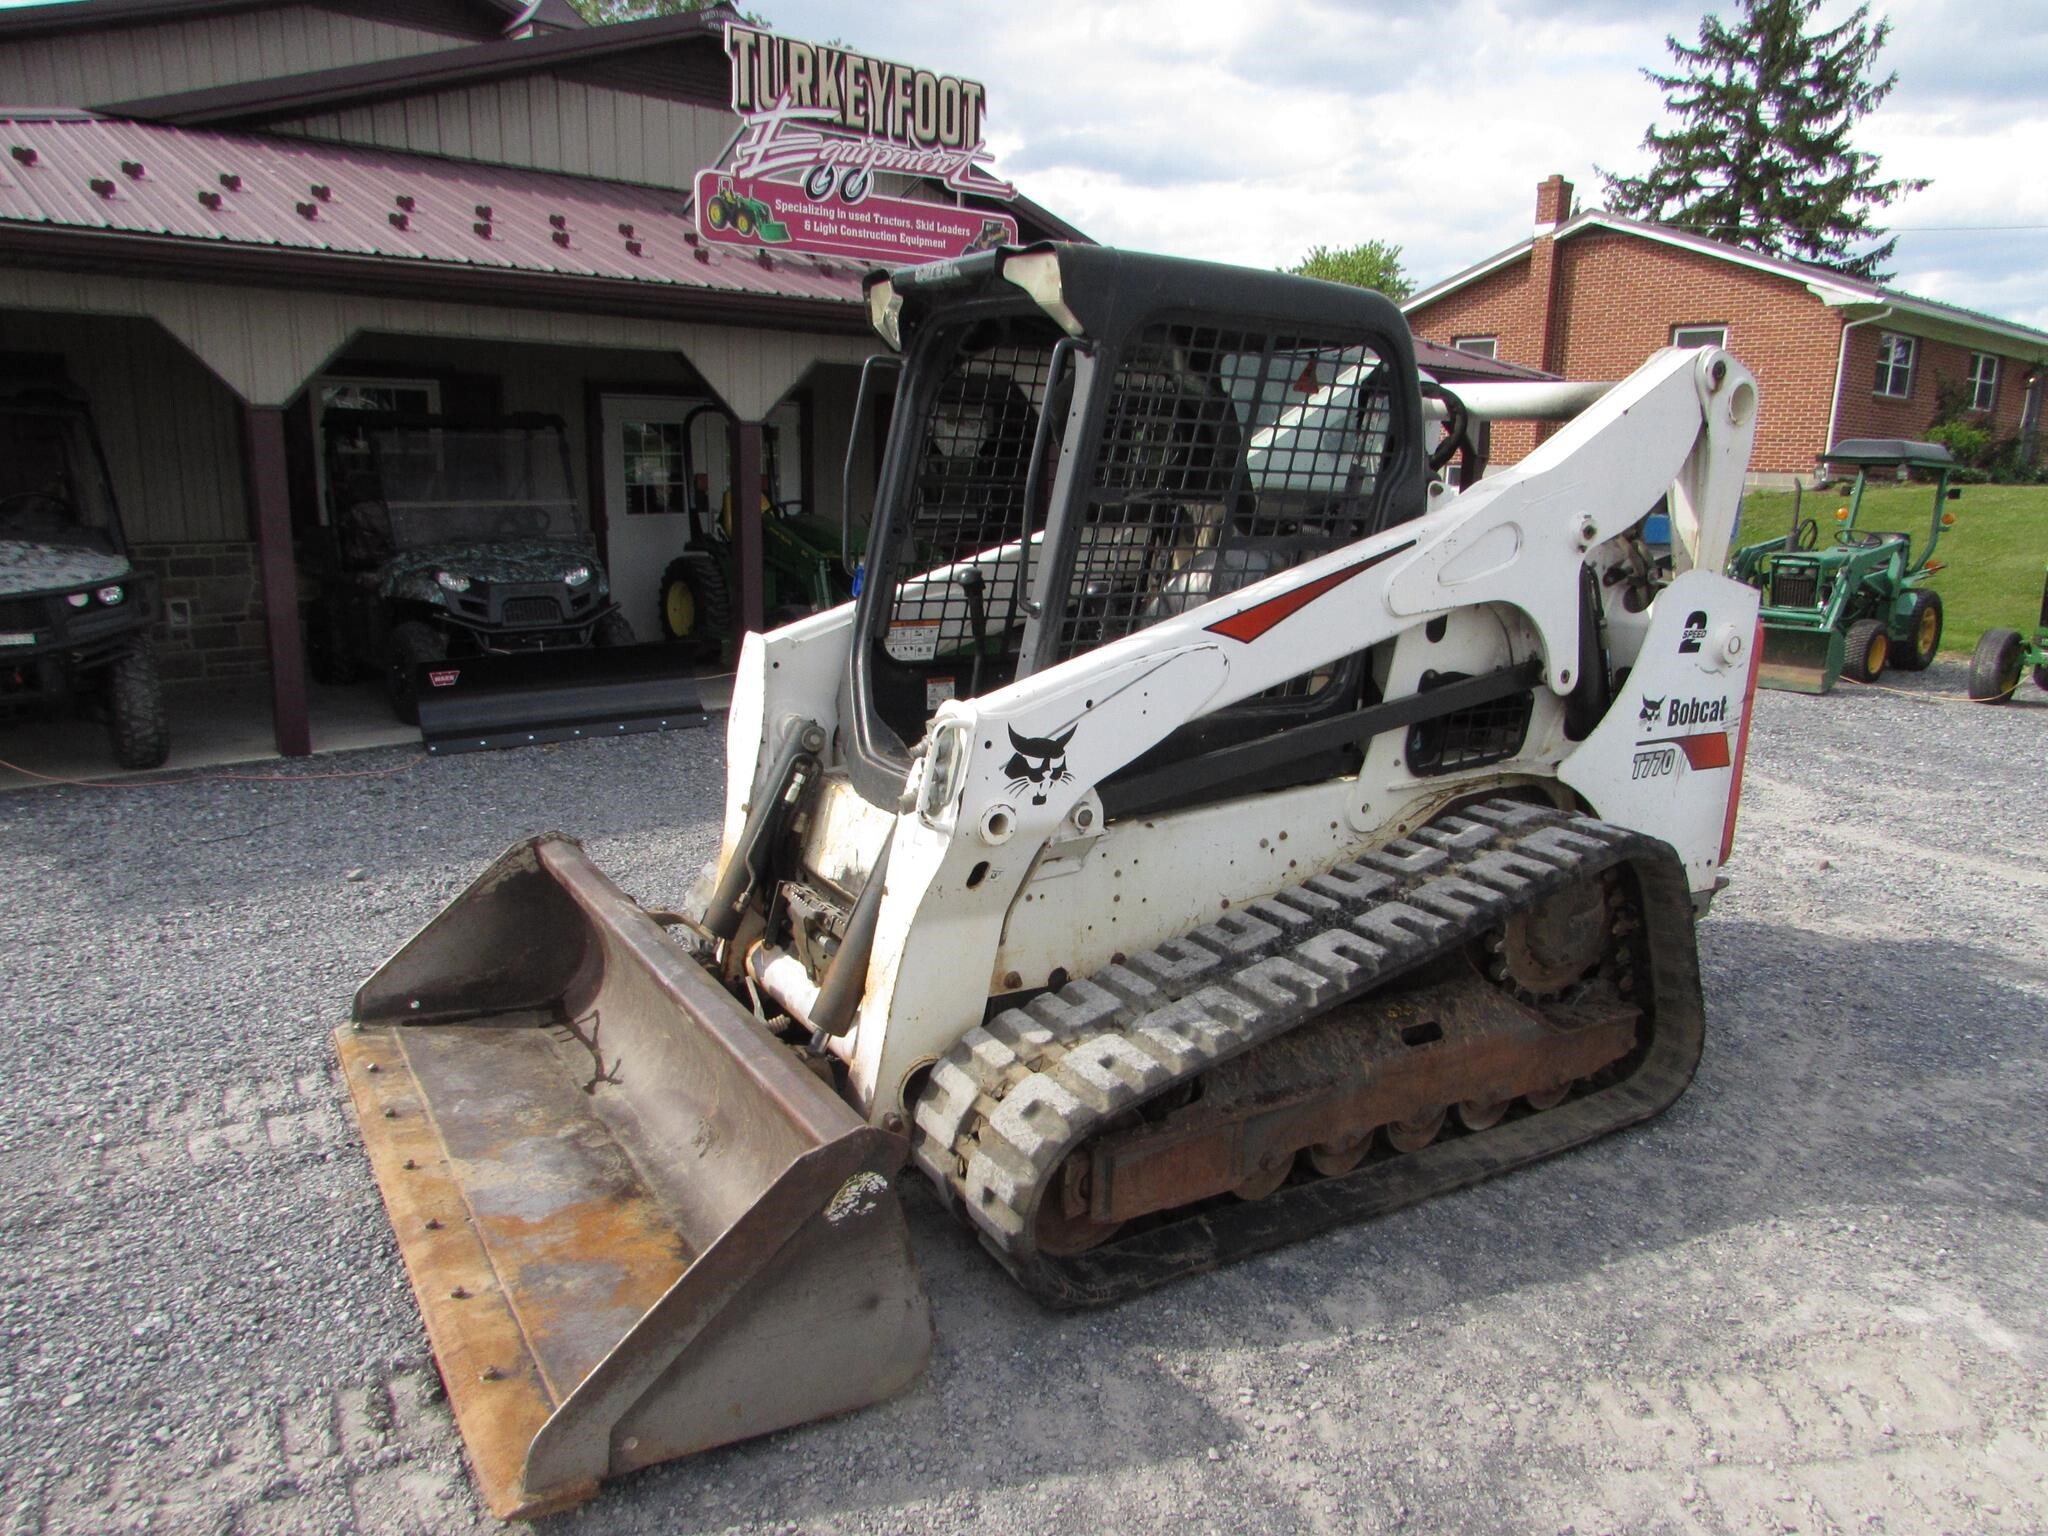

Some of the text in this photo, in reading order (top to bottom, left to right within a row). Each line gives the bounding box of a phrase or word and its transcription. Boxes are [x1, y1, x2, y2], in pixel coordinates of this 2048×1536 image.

[729, 27, 986, 149] TURKEYFOOT
[737, 94, 1016, 197] Equipment
[775, 199, 835, 219] Specializing
[837, 207, 847, 219] in
[848, 211, 871, 223] used
[916, 218, 935, 232] Skid
[937, 221, 971, 237] Loaders
[804, 219, 947, 249] & Light Construction Equipment
[1678, 610, 1708, 654] 2
[1682, 629, 1707, 639] SPEED
[1667, 696, 1727, 727] Bobcat
[1632, 748, 1676, 780] T770
